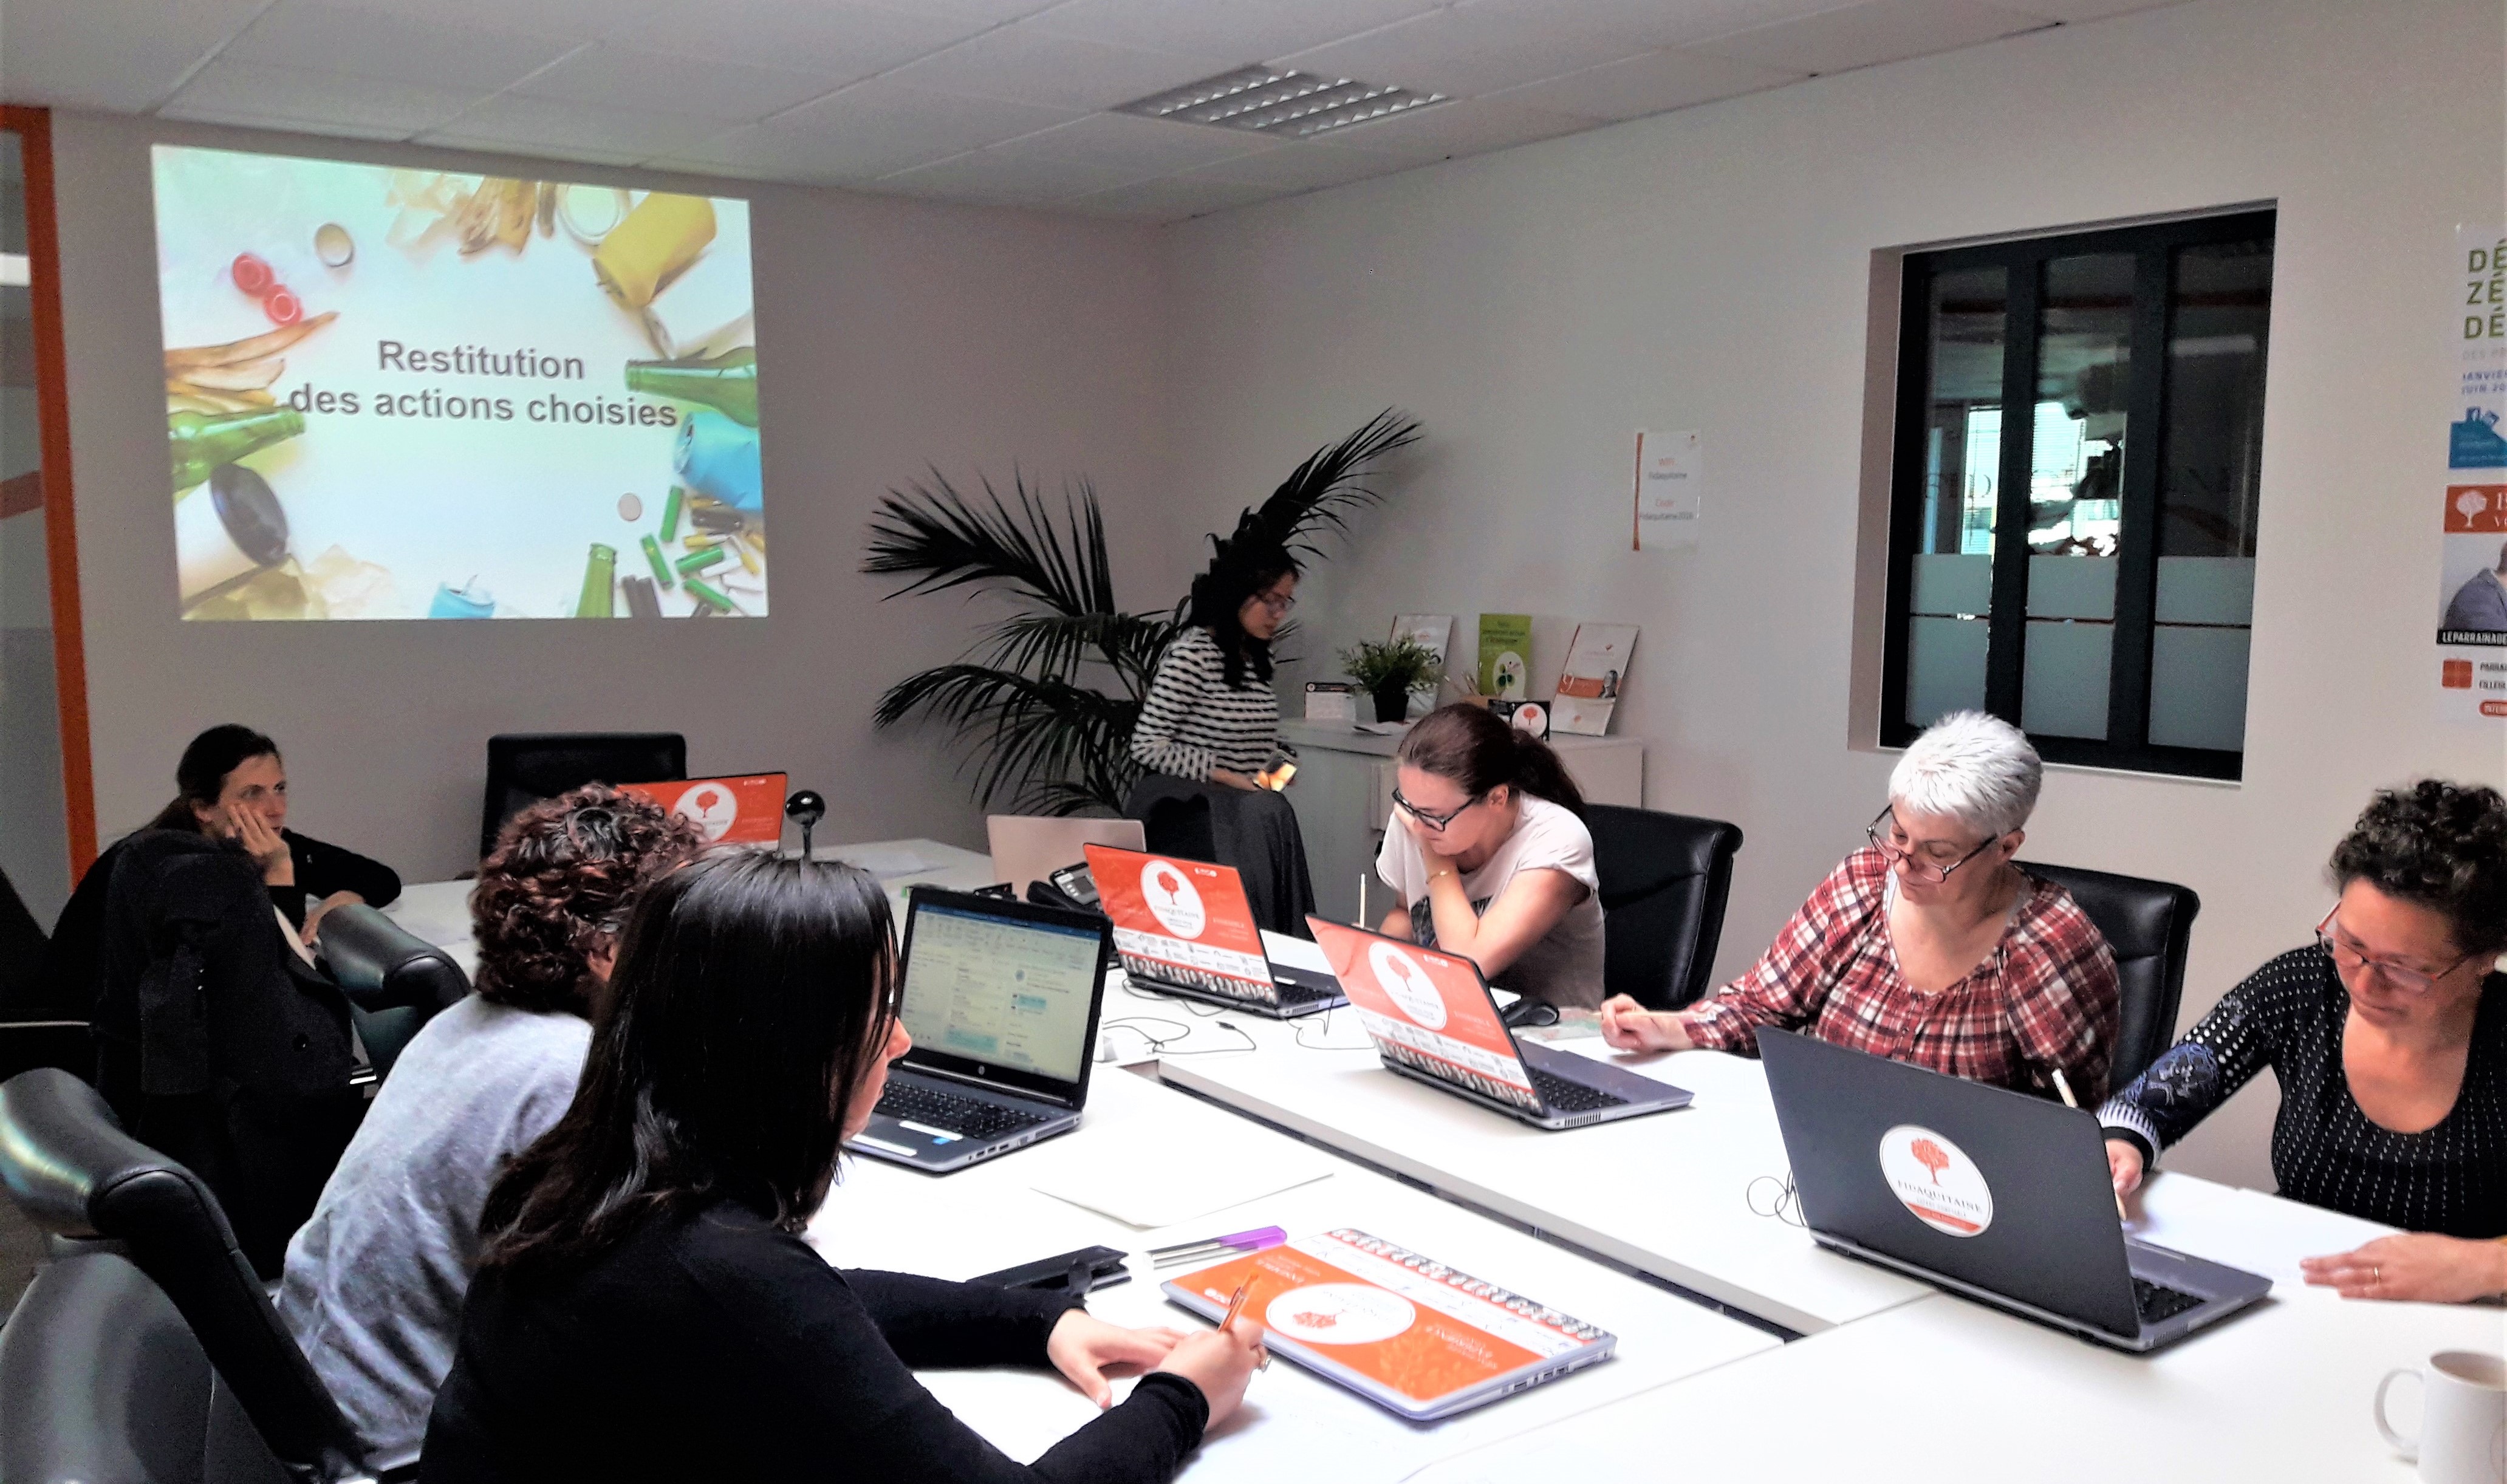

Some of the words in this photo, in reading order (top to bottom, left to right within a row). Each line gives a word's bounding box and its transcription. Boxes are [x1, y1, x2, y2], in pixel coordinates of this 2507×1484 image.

[378, 340, 585, 380] Restitution
[2462, 369, 2507, 381] JANVIE
[289, 384, 360, 415] des
[375, 388, 513, 420] actions
[527, 394, 677, 426] choisies
